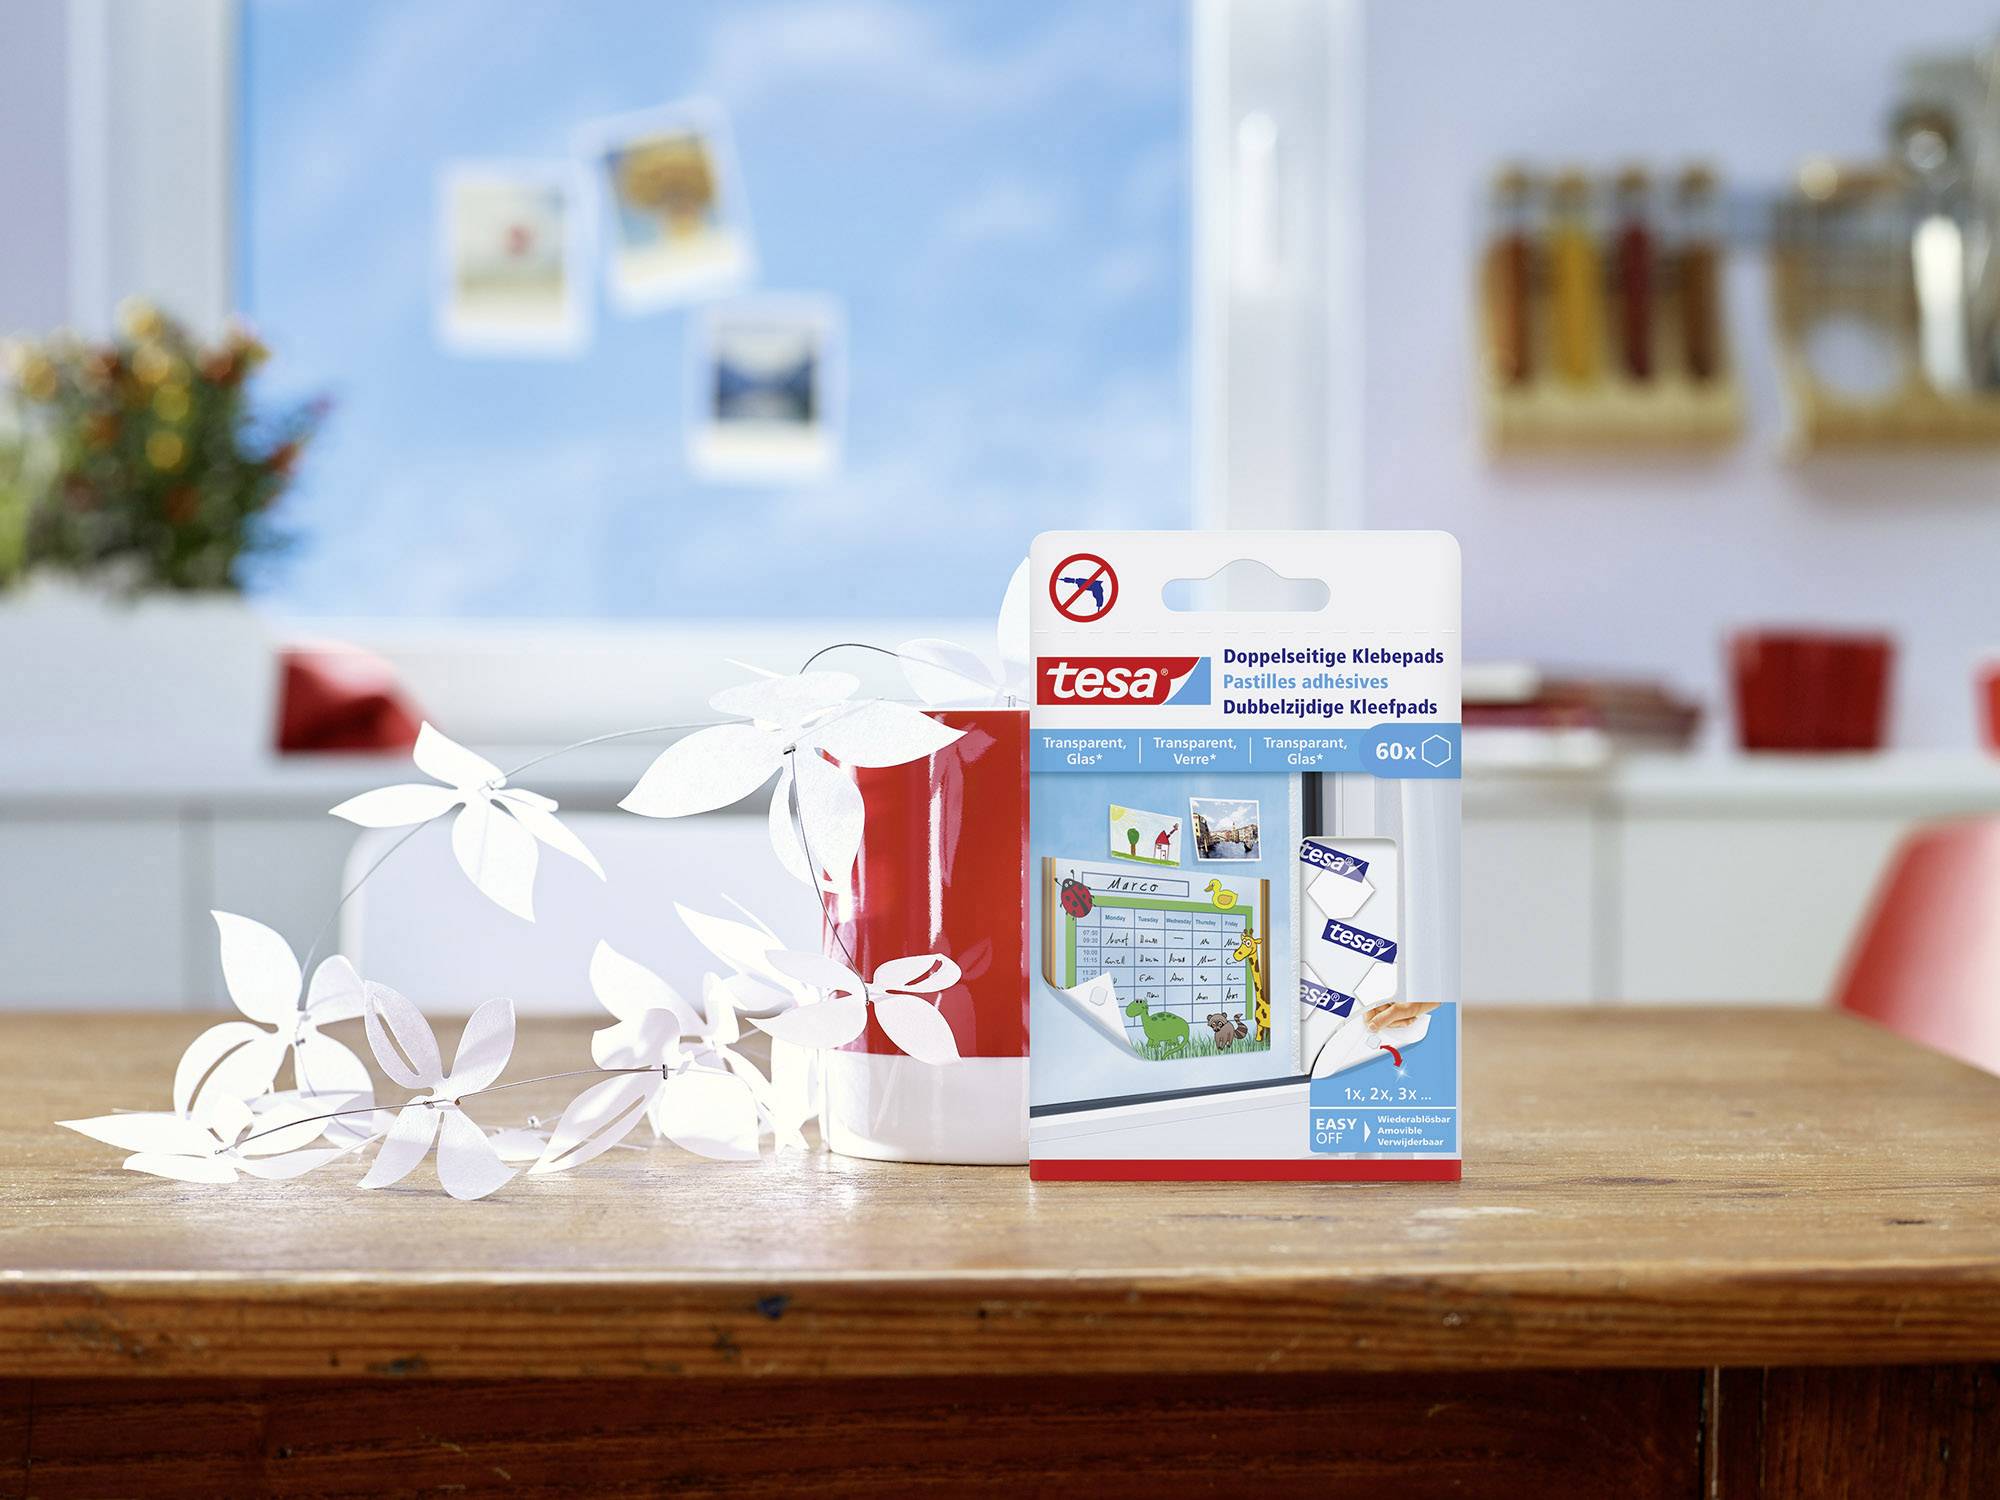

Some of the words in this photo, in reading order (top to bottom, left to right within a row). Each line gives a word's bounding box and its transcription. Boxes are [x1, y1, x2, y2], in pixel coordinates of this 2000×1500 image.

[1223, 648, 1347, 667] Doppelseitige
[1352, 648, 1444, 667] Klebepads
[1223, 673, 1296, 689] Pastilles
[1302, 673, 1389, 689] adhésives
[1223, 699, 1344, 718] Dubbelzijdige
[1350, 699, 1438, 718] Kleefpads
[1043, 737, 1127, 751] Transparent,
[1153, 737, 1237, 751] Transparent,
[1263, 737, 1348, 751] Transparant,
[1375, 742, 1417, 760] 60x
[1107, 877, 1158, 892] Marco
[1105, 914, 1126, 922] Monday
[1344, 1087, 1365, 1101] 1x,
[1370, 1087, 1393, 1101] 2x,
[1398, 1087, 1417, 1100] 3x
[1316, 1118, 1357, 1130] EASY
[1377, 1115, 1451, 1124] Wiederablösbar
[1377, 1126, 1423, 1135] Amovible
[1316, 1132, 1343, 1145] OFF
[1377, 1138, 1444, 1147] Verwijderbaar
